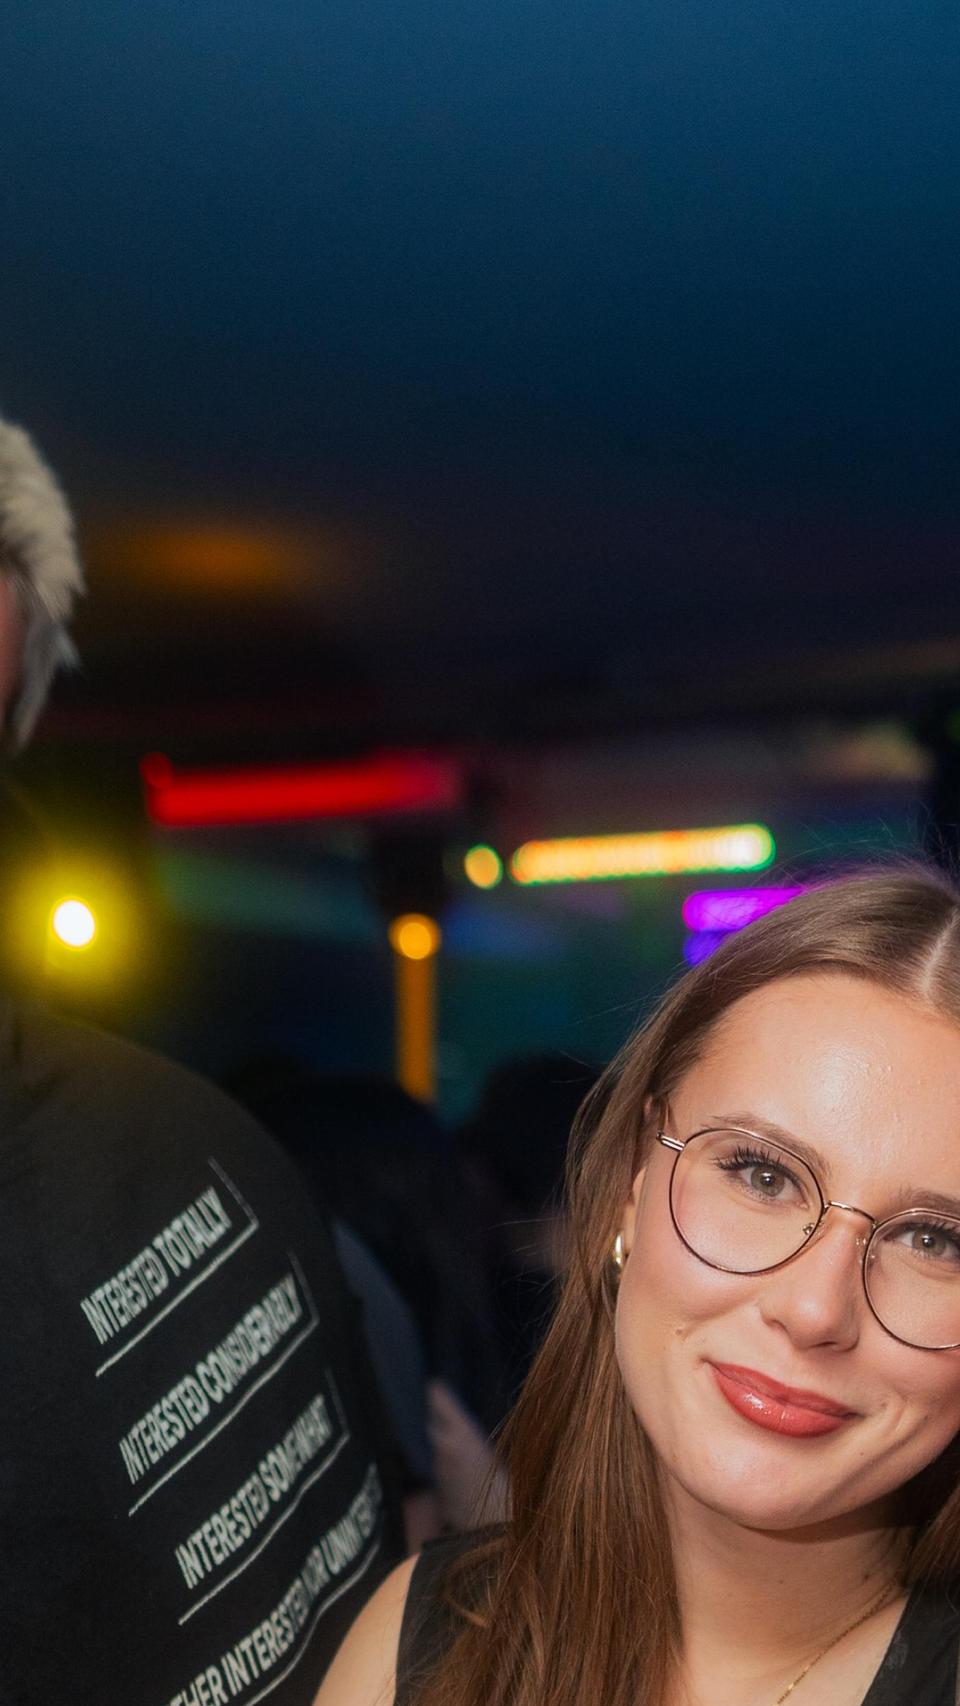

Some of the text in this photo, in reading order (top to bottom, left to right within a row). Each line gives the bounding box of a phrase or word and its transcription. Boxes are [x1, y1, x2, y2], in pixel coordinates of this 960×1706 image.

[80, 1185, 232, 1344] INTERESTED TOTALLY
[119, 1273, 302, 1485] INTERESTED CONSIDERABLY
[175, 1394, 332, 1589] INTERESTED SOMEWHAT
[220, 1577, 311, 1696] INTERESTED
